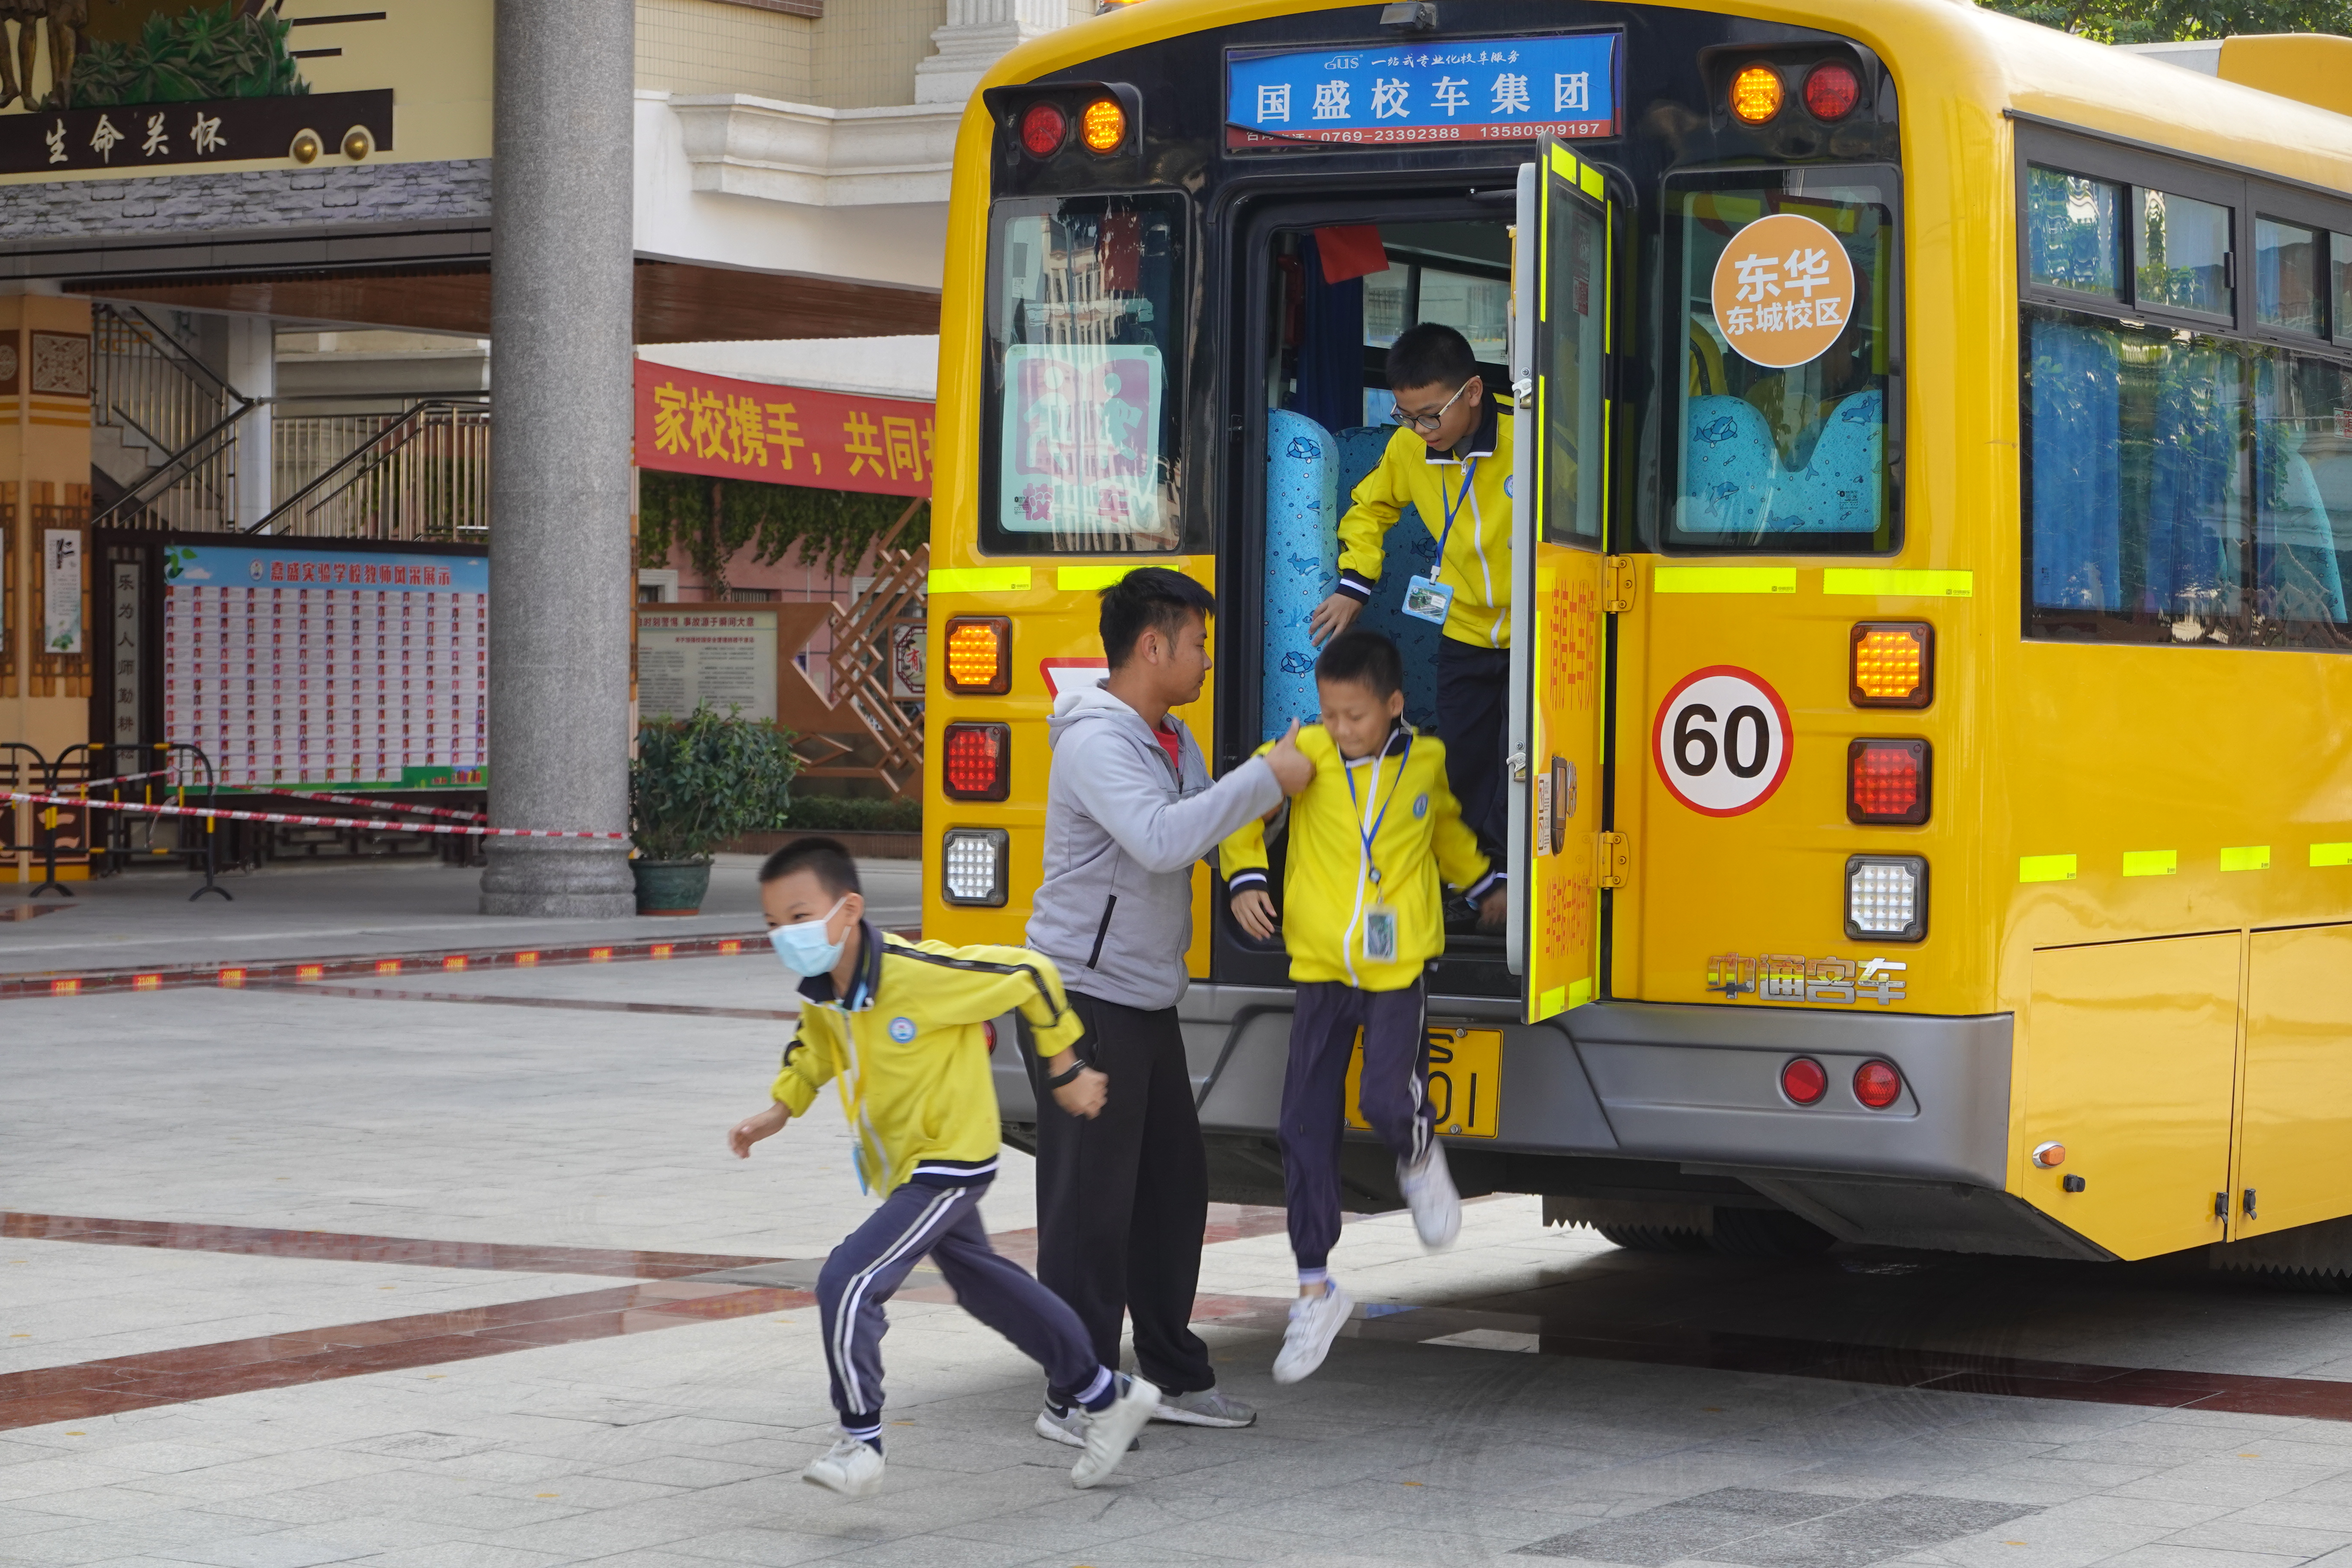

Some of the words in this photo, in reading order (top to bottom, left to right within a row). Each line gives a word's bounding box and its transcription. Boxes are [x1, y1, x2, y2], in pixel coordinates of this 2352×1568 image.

[1371, 49, 1520, 68] 一站式专业化校车服务
[1257, 71, 1590, 124] 国盛校车集团
[45, 111, 227, 164] 生命关怀
[1321, 128, 1460, 142] 0769-23392388
[1480, 123, 1600, 138] 13580909197
[1734, 248, 1830, 302] 东华
[1726, 297, 1843, 335] 东城校区
[1022, 483, 1130, 524] 校车
[270, 561, 450, 586] 嘉盛实验学校教师风采展示
[683, 617, 754, 627] 事故源于瞬间大意
[1672, 703, 1770, 778] 60
[1705, 952, 1907, 1006] 中通客车
